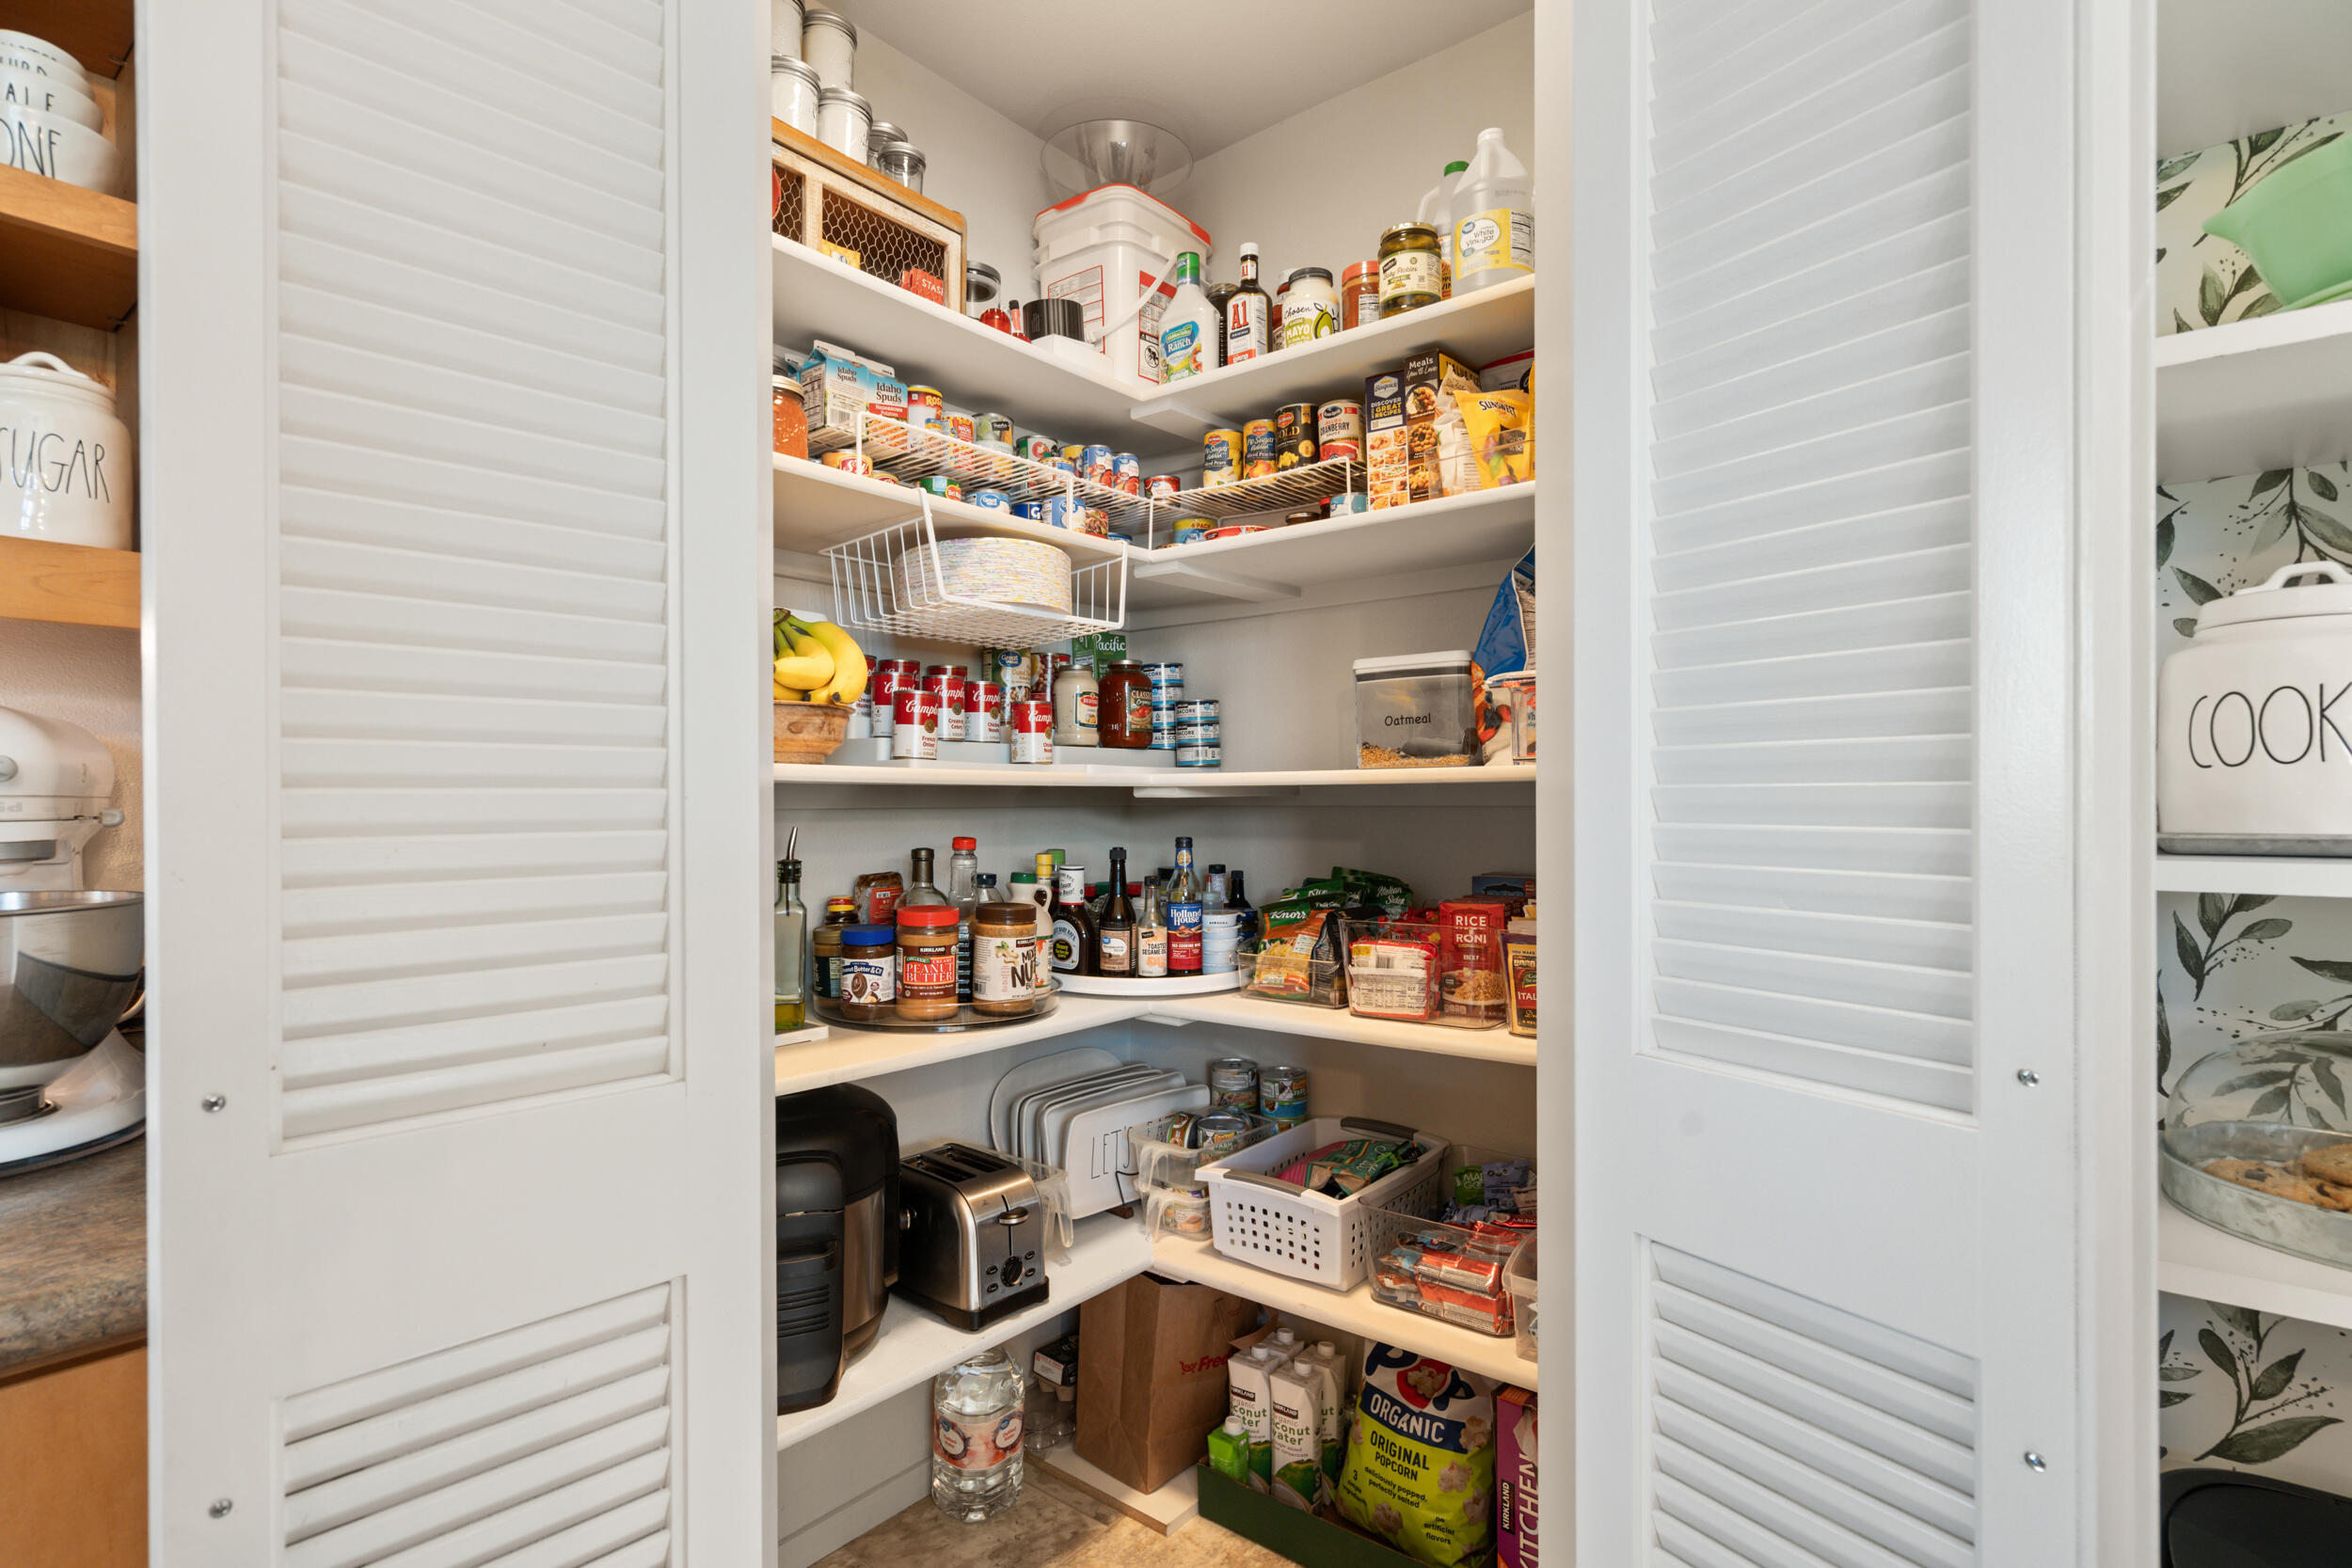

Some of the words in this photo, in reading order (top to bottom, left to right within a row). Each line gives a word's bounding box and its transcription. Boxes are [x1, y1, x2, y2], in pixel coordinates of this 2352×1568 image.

[1473, 229, 1495, 239] White
[1466, 235, 1495, 247] Vinegar
[1232, 300, 1249, 330] A1
[1284, 306, 1312, 319] Chosen
[1286, 324, 1311, 340] MAYO
[1168, 337, 1192, 353] Ranch
[1408, 356, 1434, 370] Meals
[837, 365, 857, 376] Idaho
[836, 373, 857, 383] Spuds
[876, 381, 902, 394] Idaho
[876, 391, 902, 404] Spuds
[1371, 397, 1402, 408] DISCOVER
[1375, 402, 1402, 413] GREAT
[1375, 408, 1402, 419] RECIPES
[1478, 400, 1517, 419] SUNSWEET
[1255, 436, 1274, 446] Sugar
[0, 425, 111, 503] UGAR
[1091, 633, 1126, 652] Pacific
[1131, 689, 1152, 700] CLASSIC
[1384, 713, 1432, 727] Oatmeal
[1385, 895, 1406, 905] Sides
[1170, 908, 1201, 920] Holland
[1269, 910, 1308, 920] Knorr
[1173, 915, 1200, 927] House
[1454, 915, 1487, 927] RICE
[1454, 933, 1487, 944] RONI
[906, 962, 952, 974] PEANUT
[906, 972, 953, 982] BUTTER
[1232, 1404, 1267, 1418] conut
[1240, 1416, 1261, 1428] ter
[1370, 1392, 1445, 1444] ORGANIC
[1272, 1420, 1311, 1435] conut
[1370, 1430, 1430, 1471] ORIGINAL
[1375, 1450, 1419, 1482] POPCORN
[1353, 1469, 1359, 1481] 3
[1364, 1466, 1397, 1490] deliciously
[1397, 1485, 1428, 1503] popped,
[1368, 1479, 1397, 1498] perfectly
[1397, 1494, 1420, 1509] salted
[1502, 1481, 1510, 1530] KIRKLAND
[1435, 1515, 1446, 1524] no
[1423, 1522, 1455, 1536] artificial
[1425, 1531, 1452, 1544] flavors
